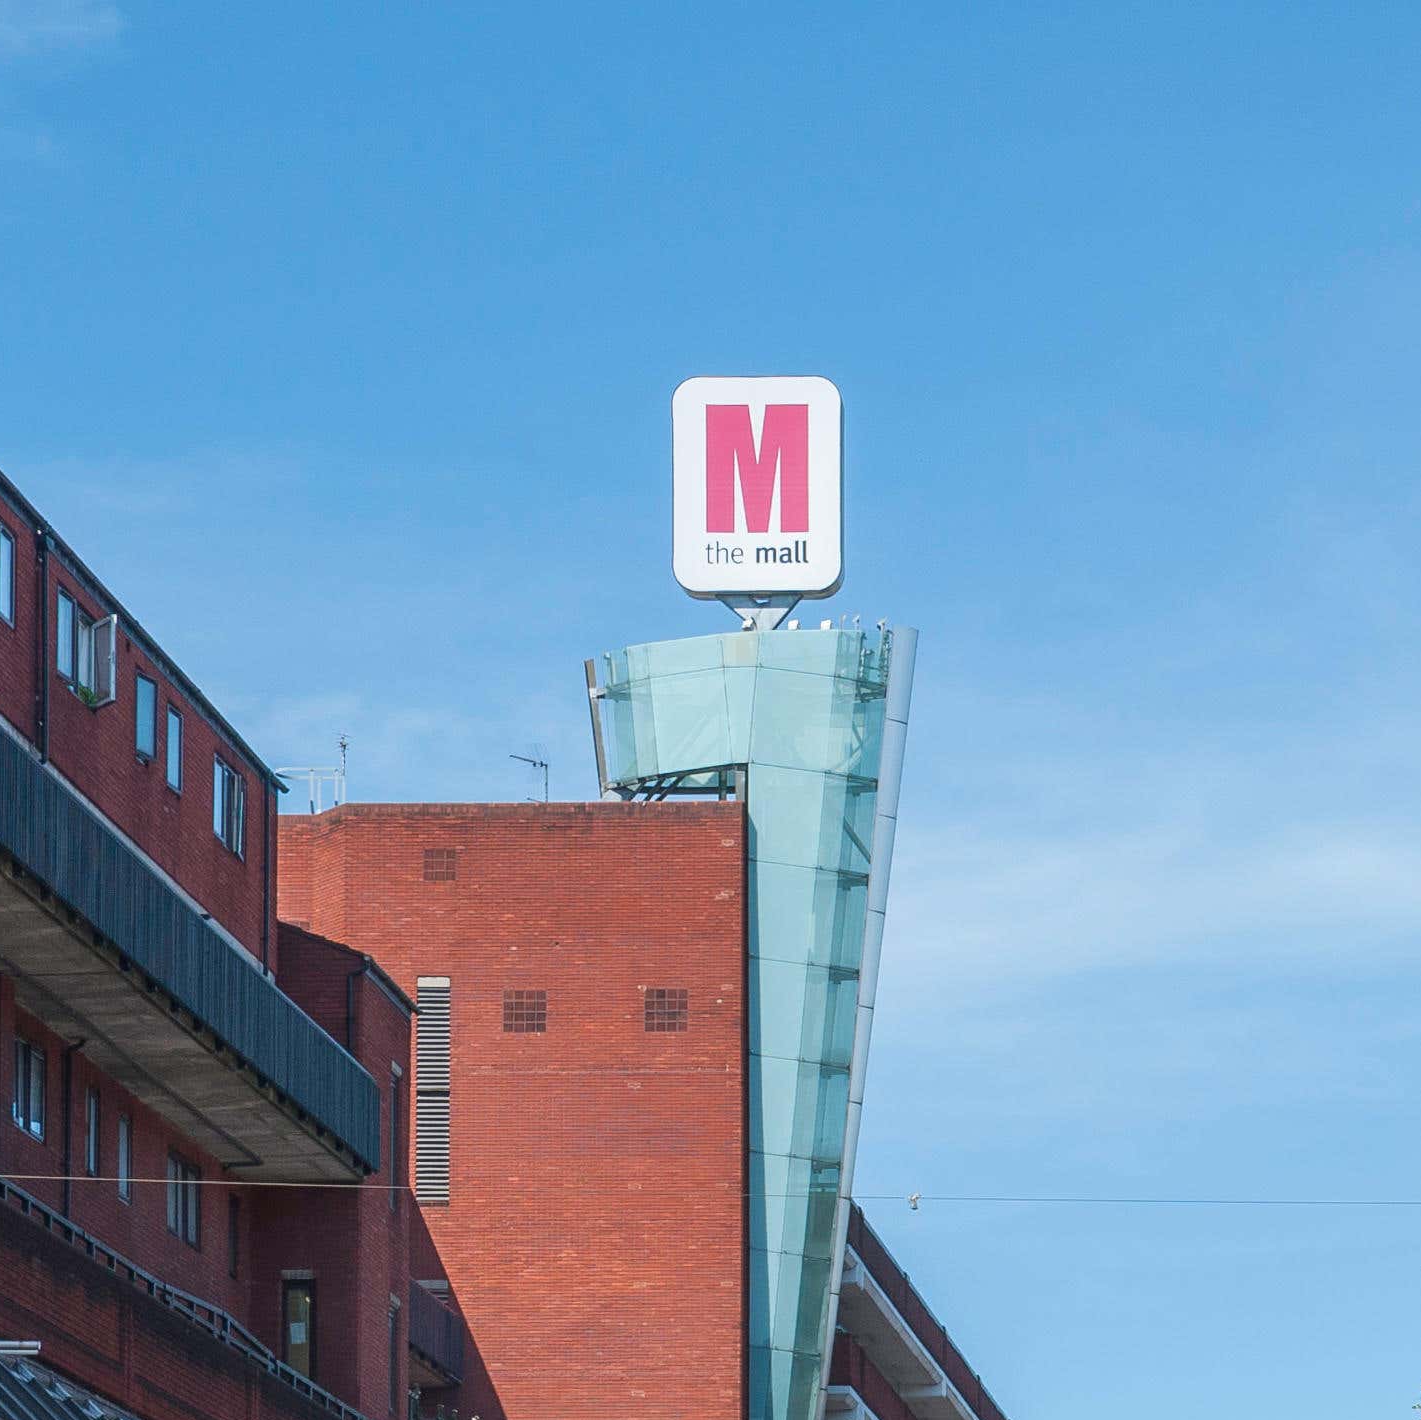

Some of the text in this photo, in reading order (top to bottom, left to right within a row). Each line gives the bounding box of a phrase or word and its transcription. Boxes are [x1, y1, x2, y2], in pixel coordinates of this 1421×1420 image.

[706, 404, 809, 533] M
[705, 540, 809, 564] the mall
